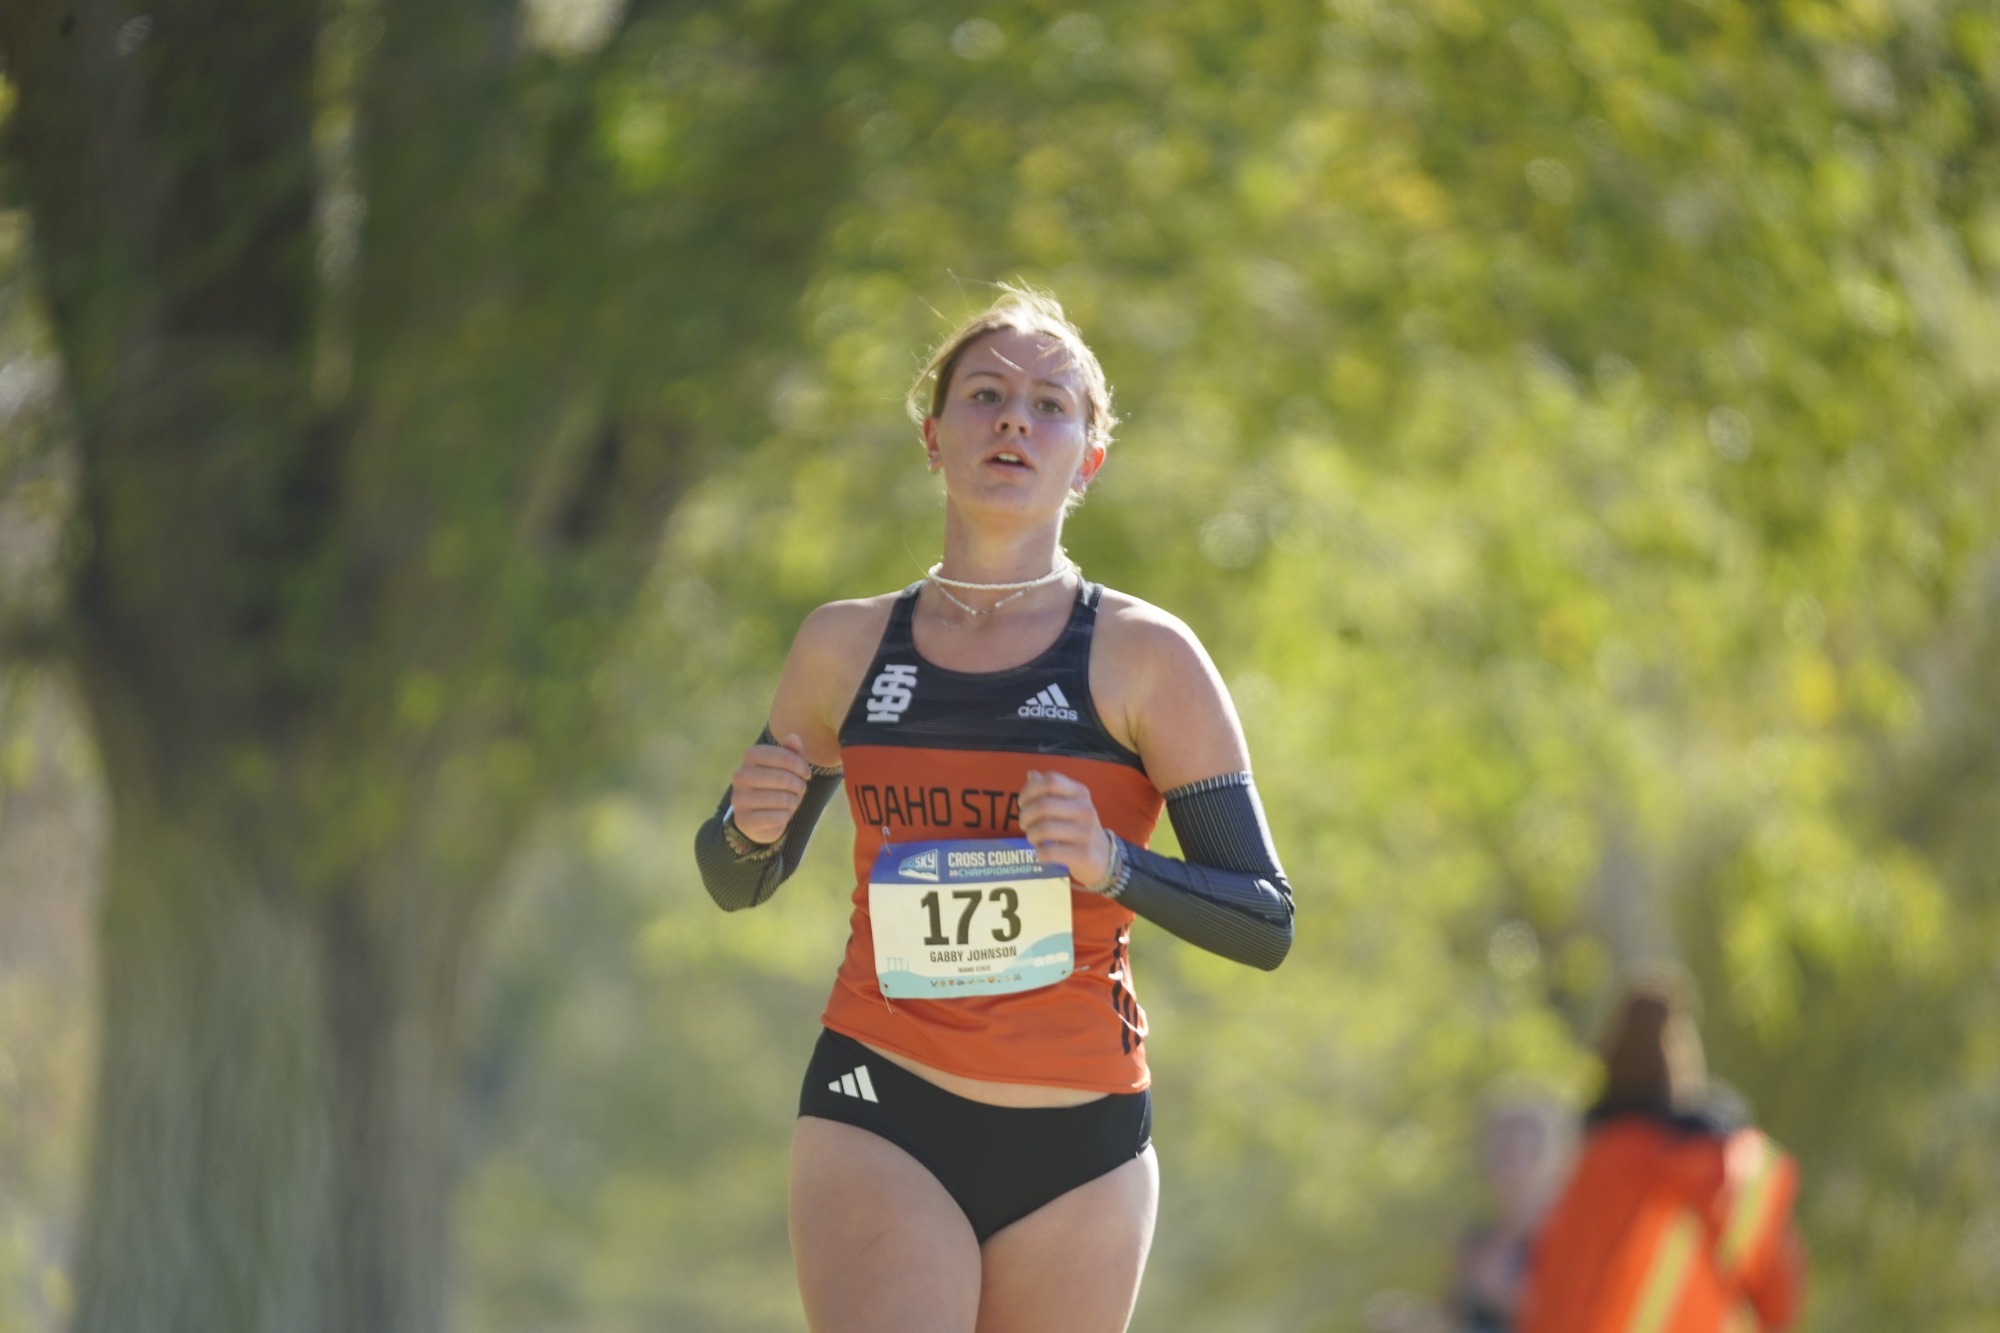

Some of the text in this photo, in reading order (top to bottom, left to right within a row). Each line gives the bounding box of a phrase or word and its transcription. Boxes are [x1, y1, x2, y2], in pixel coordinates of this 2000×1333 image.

[1017, 704, 1079, 721] adidas
[854, 785, 1022, 831] IDAHO STA
[915, 852, 935, 868] SKY
[947, 848, 1039, 867] CROSS COUNTR
[958, 864, 1032, 877] CHAMPIONSHIP
[920, 886, 1022, 946] 173
[930, 945, 1017, 963] GABBY JOHNSON
